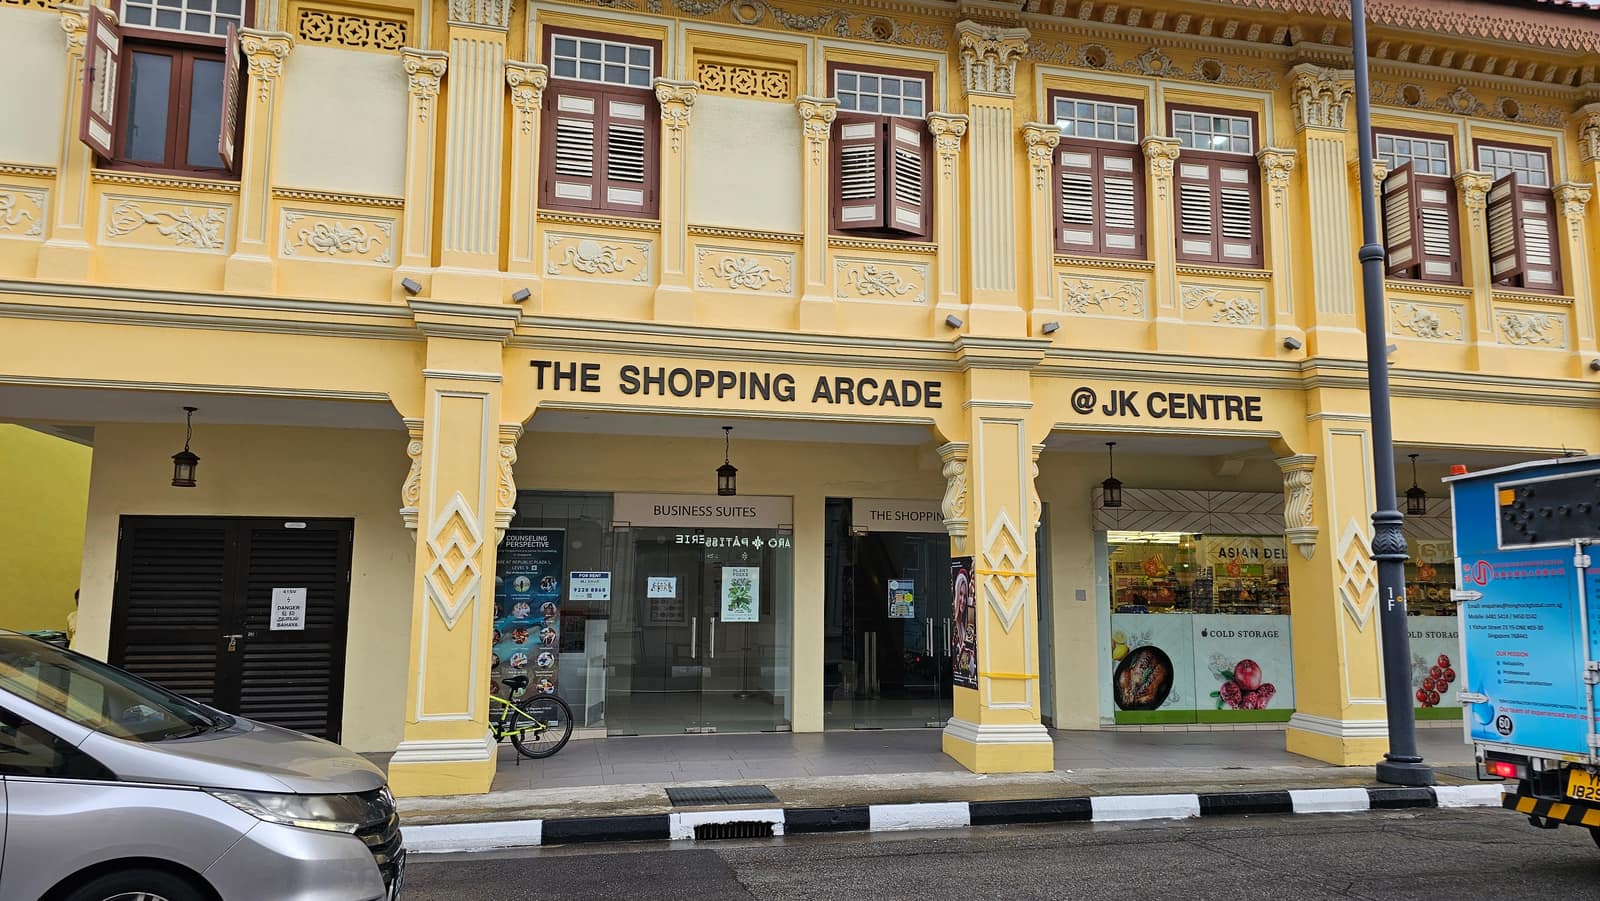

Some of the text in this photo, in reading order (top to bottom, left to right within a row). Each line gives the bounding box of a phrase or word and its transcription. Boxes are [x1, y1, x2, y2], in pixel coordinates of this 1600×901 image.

[530, 360, 943, 408] THE SHOPPING ARCADE
[1071, 386, 1263, 422] @ JK CENTRE
[653, 504, 757, 518] BUSINESS SUITES
[869, 510, 893, 521] THE
[1218, 547, 1259, 559] ASIAN
[1209, 630, 1280, 638] COLD STORAGE
[1499, 716, 1510, 729] 60
